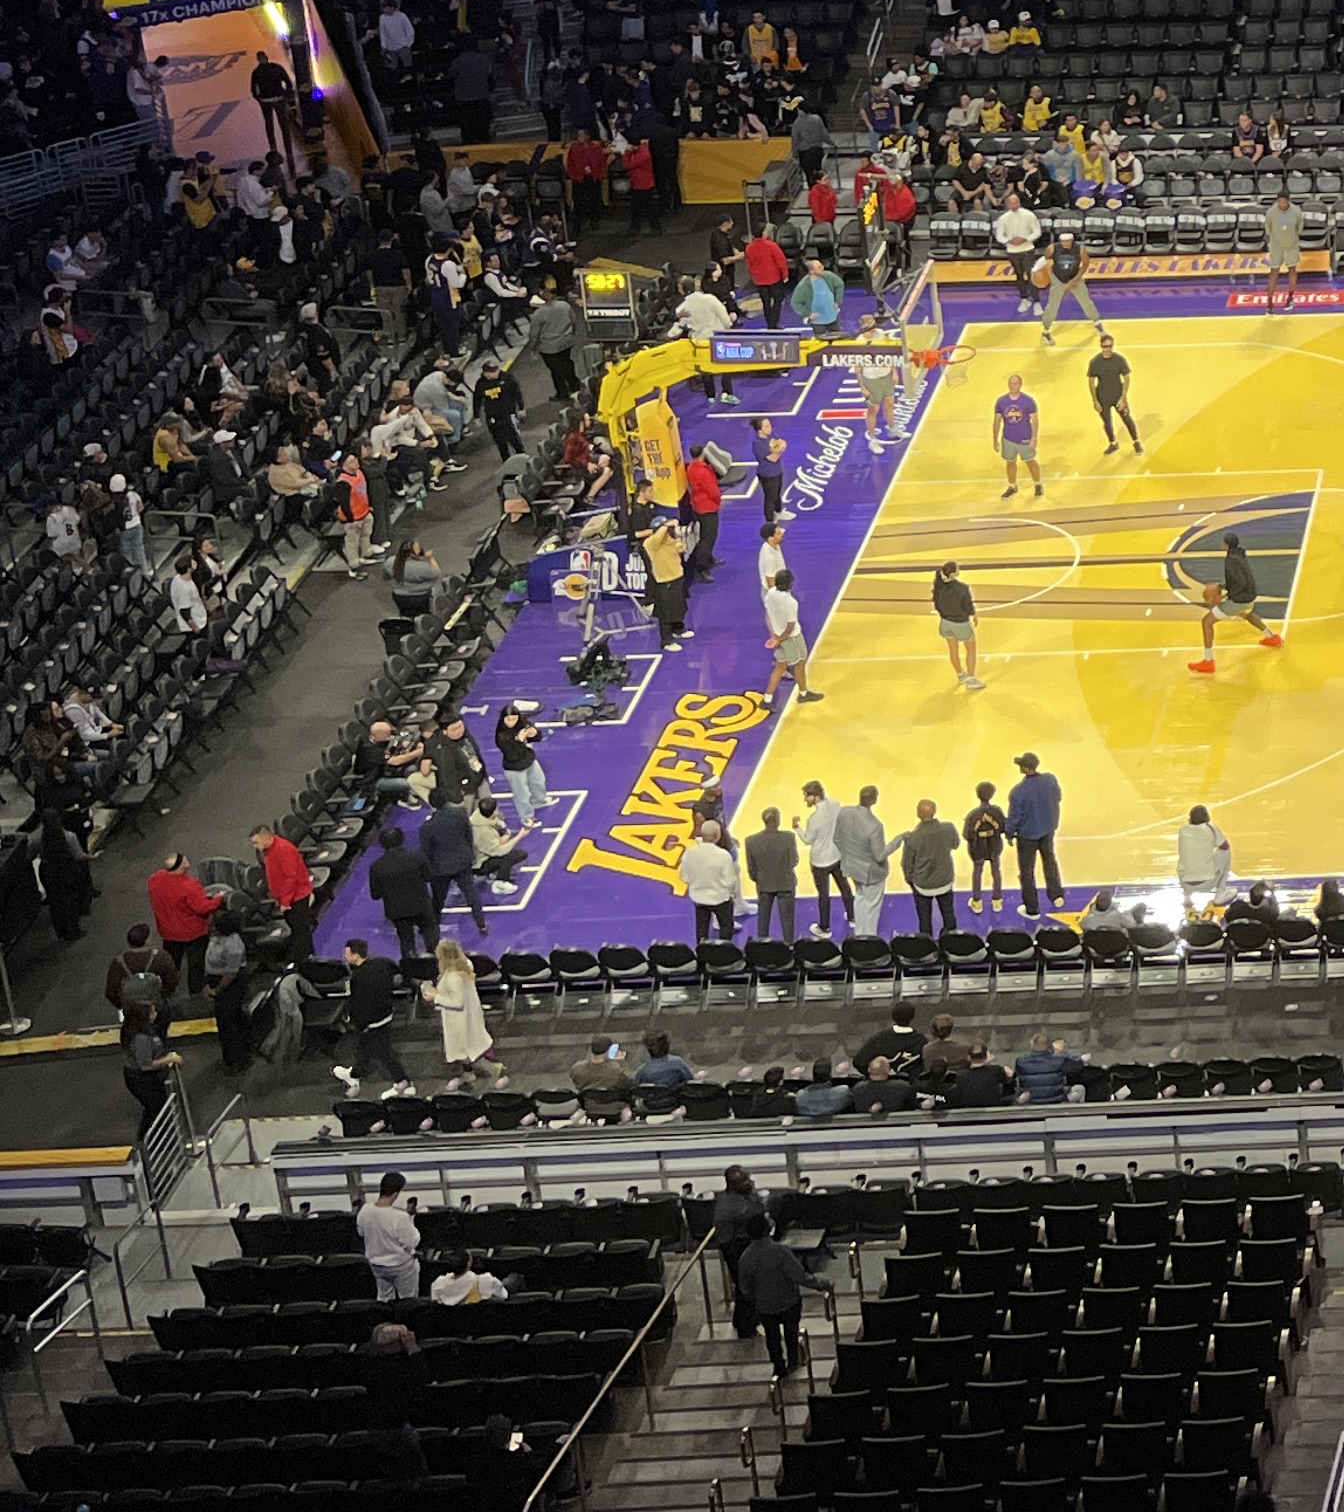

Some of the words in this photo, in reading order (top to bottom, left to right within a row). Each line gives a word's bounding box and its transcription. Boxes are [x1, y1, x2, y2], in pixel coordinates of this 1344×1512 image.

[140, 9, 169, 24] 17x
[1168, 253, 1272, 276] LAKERS
[822, 354, 905, 368] LAKERS.COM
[782, 424, 854, 510] Michelob
[565, 690, 771, 898] LAKERS
